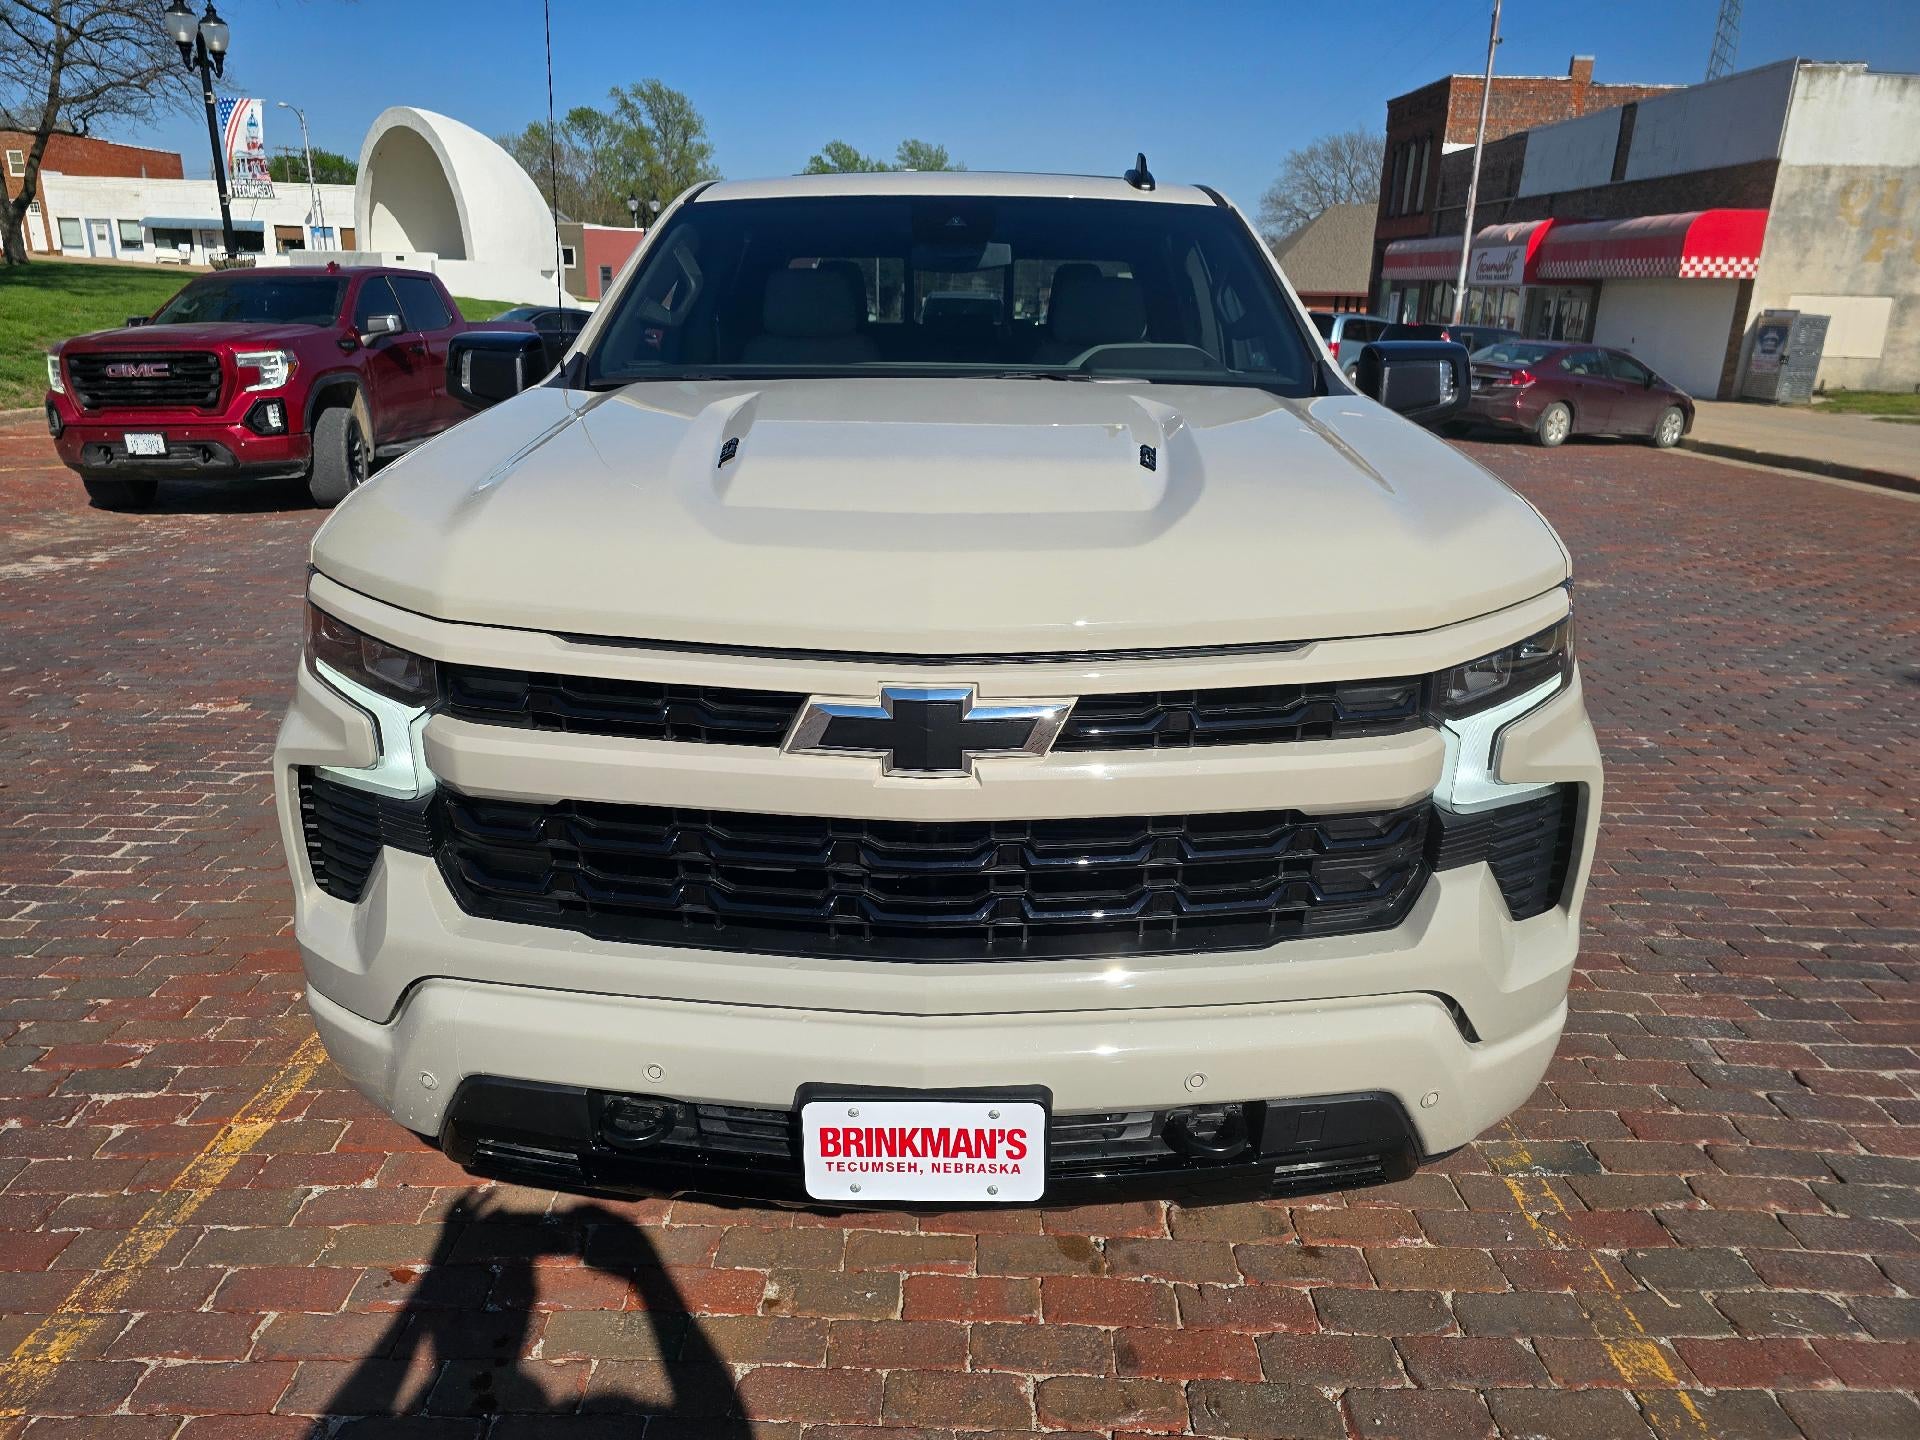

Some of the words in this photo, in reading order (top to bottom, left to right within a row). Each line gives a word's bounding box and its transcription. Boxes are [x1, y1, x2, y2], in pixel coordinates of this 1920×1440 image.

[106, 363, 169, 378] GMC
[819, 1127, 1028, 1161] BRINKMAN'S
[826, 1161, 924, 1175] TECUMSEH,
[931, 1162, 1021, 1175] NEBRASKA
